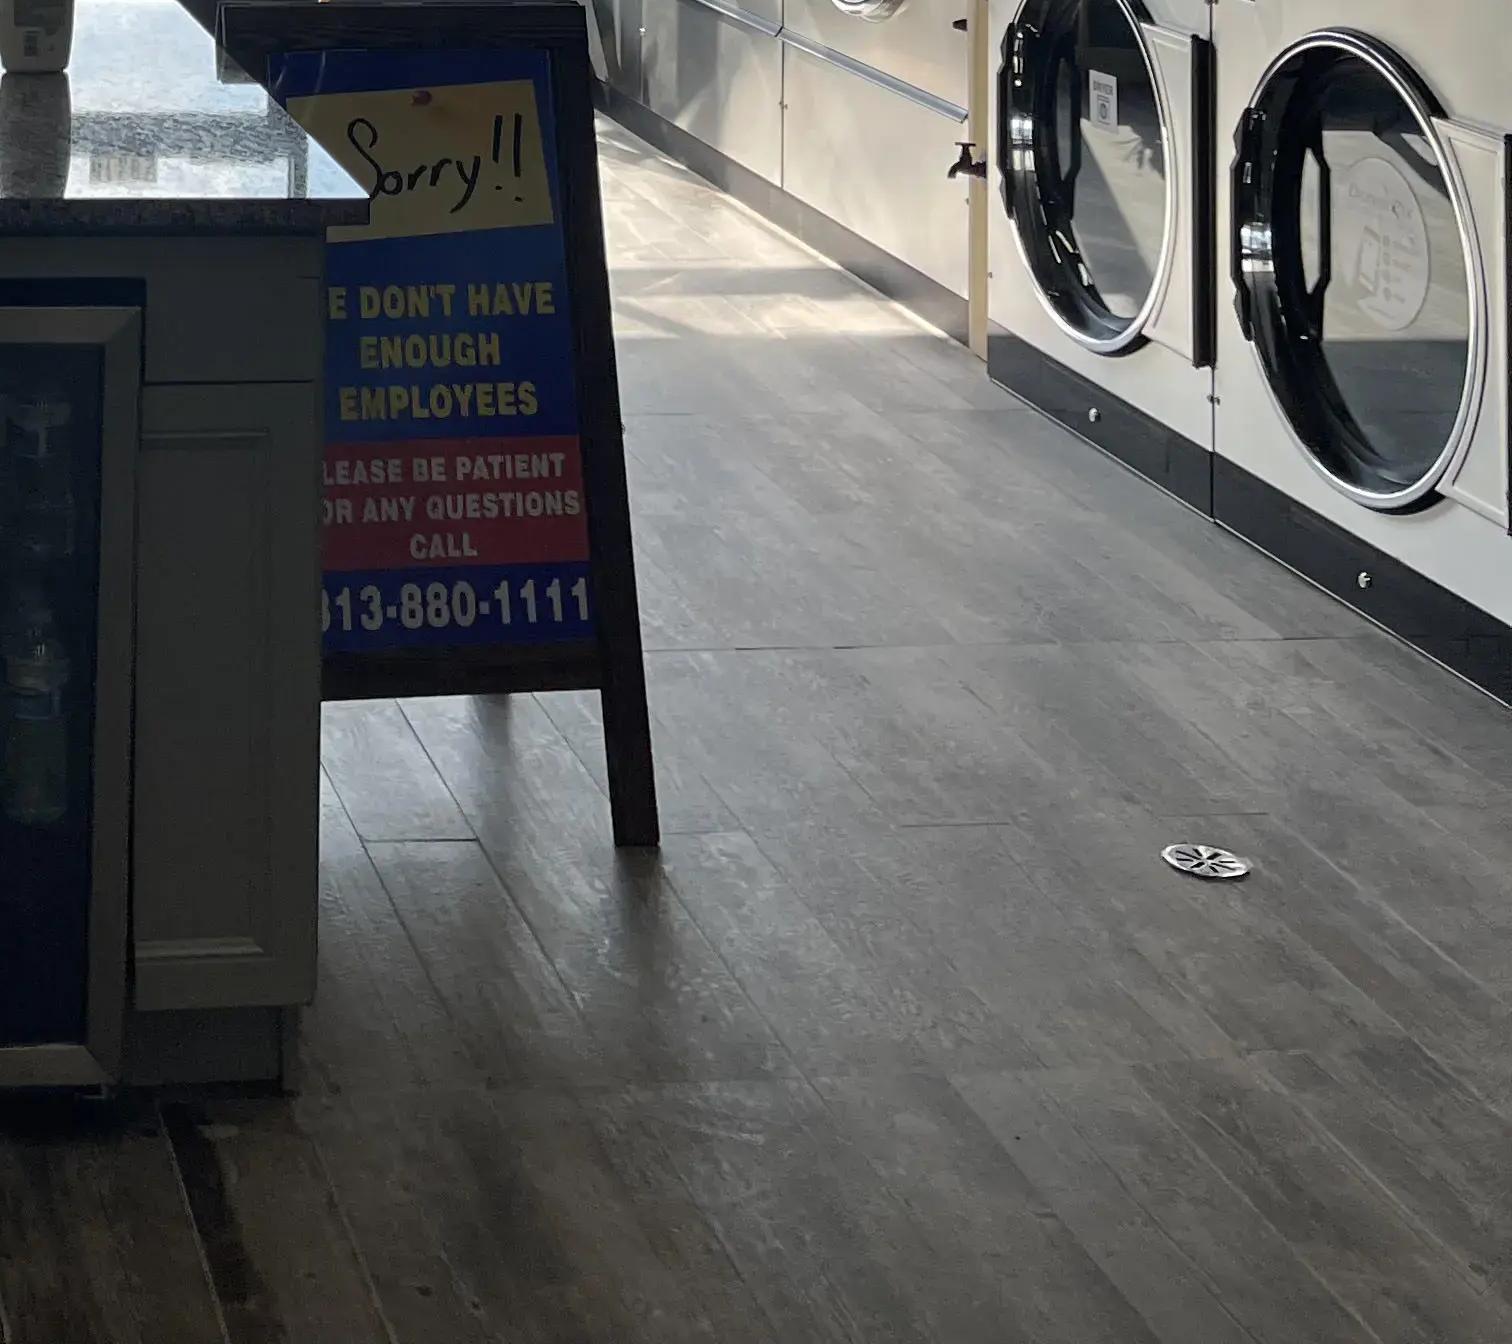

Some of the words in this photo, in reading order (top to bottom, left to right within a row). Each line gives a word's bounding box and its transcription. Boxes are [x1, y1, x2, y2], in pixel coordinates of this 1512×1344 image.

[346, 112, 524, 214] Sorry!!
[328, 286, 348, 321] E
[360, 283, 456, 319] DON'T
[468, 281, 557, 316] HAVE
[359, 333, 501, 370] ENOUGH
[339, 381, 539, 421] EMPLOYEES
[322, 457, 403, 487] LEASE
[412, 457, 447, 483] BE
[456, 452, 566, 482] PATIENT
[322, 498, 354, 526] OR
[362, 495, 416, 523] ANY
[426, 490, 580, 520] QUESTIONS
[409, 532, 478, 561] CALL
